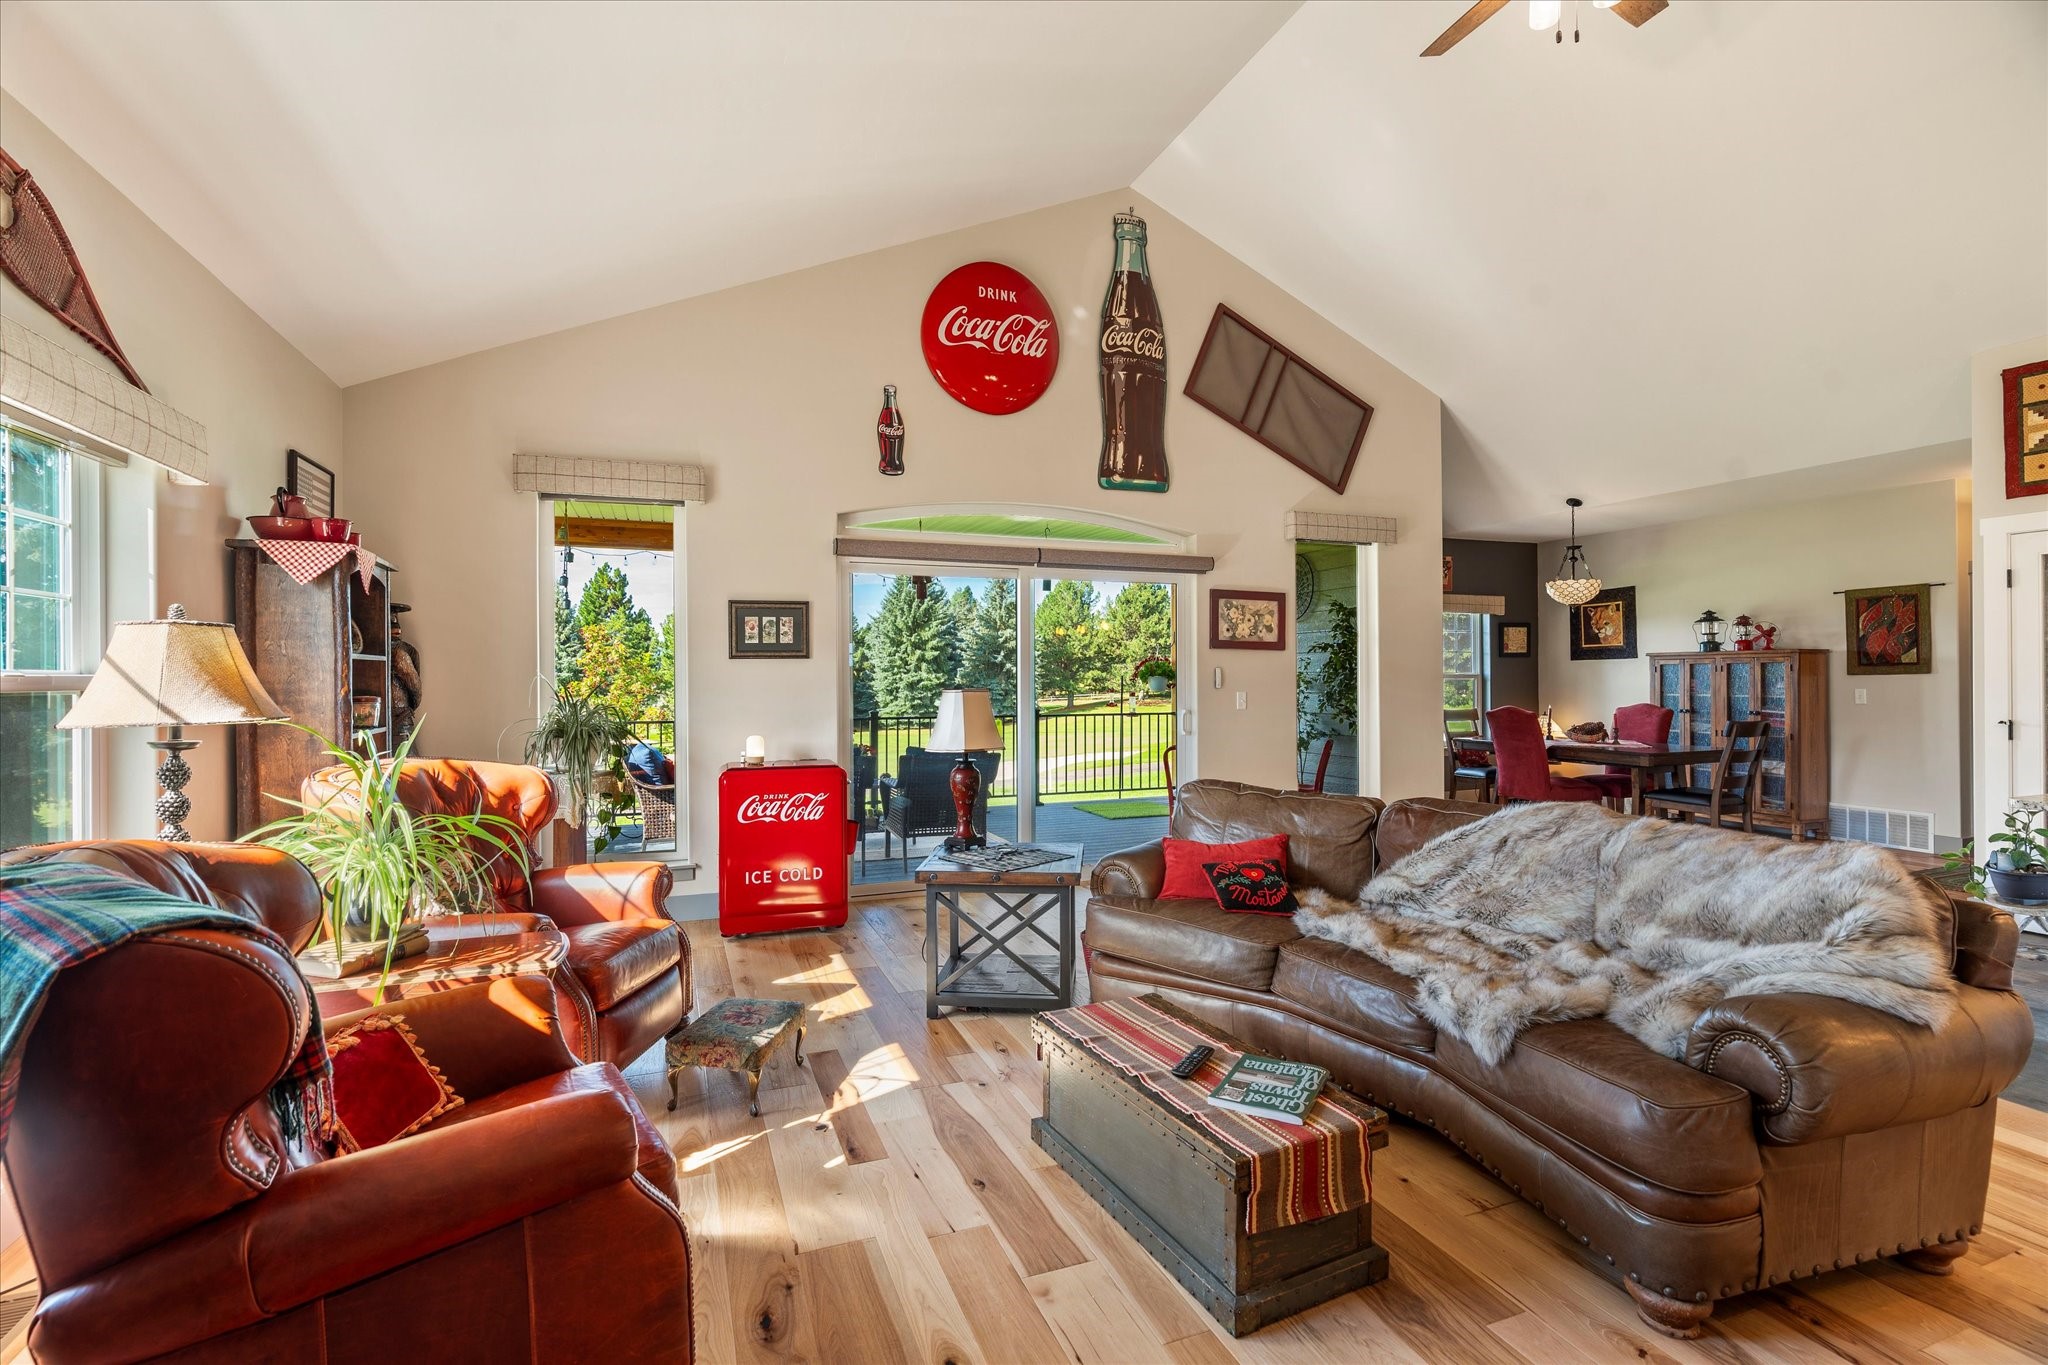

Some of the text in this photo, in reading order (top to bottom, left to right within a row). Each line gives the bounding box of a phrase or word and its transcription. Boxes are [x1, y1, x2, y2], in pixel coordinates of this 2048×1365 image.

[978, 286, 1017, 303] DRINK
[937, 305, 1052, 359] Coca-Cola
[1101, 325, 1165, 360] Coca-Cola
[878, 423, 904, 436] Coca-Cola
[737, 792, 830, 824] Coca-Cola
[745, 866, 824, 885] ICE COLD
[1243, 1059, 1323, 1084] Montana
[1249, 1082, 1309, 1105] Towns
[1294, 1077, 1318, 1090] of
[1245, 1092, 1305, 1114] Ghost
